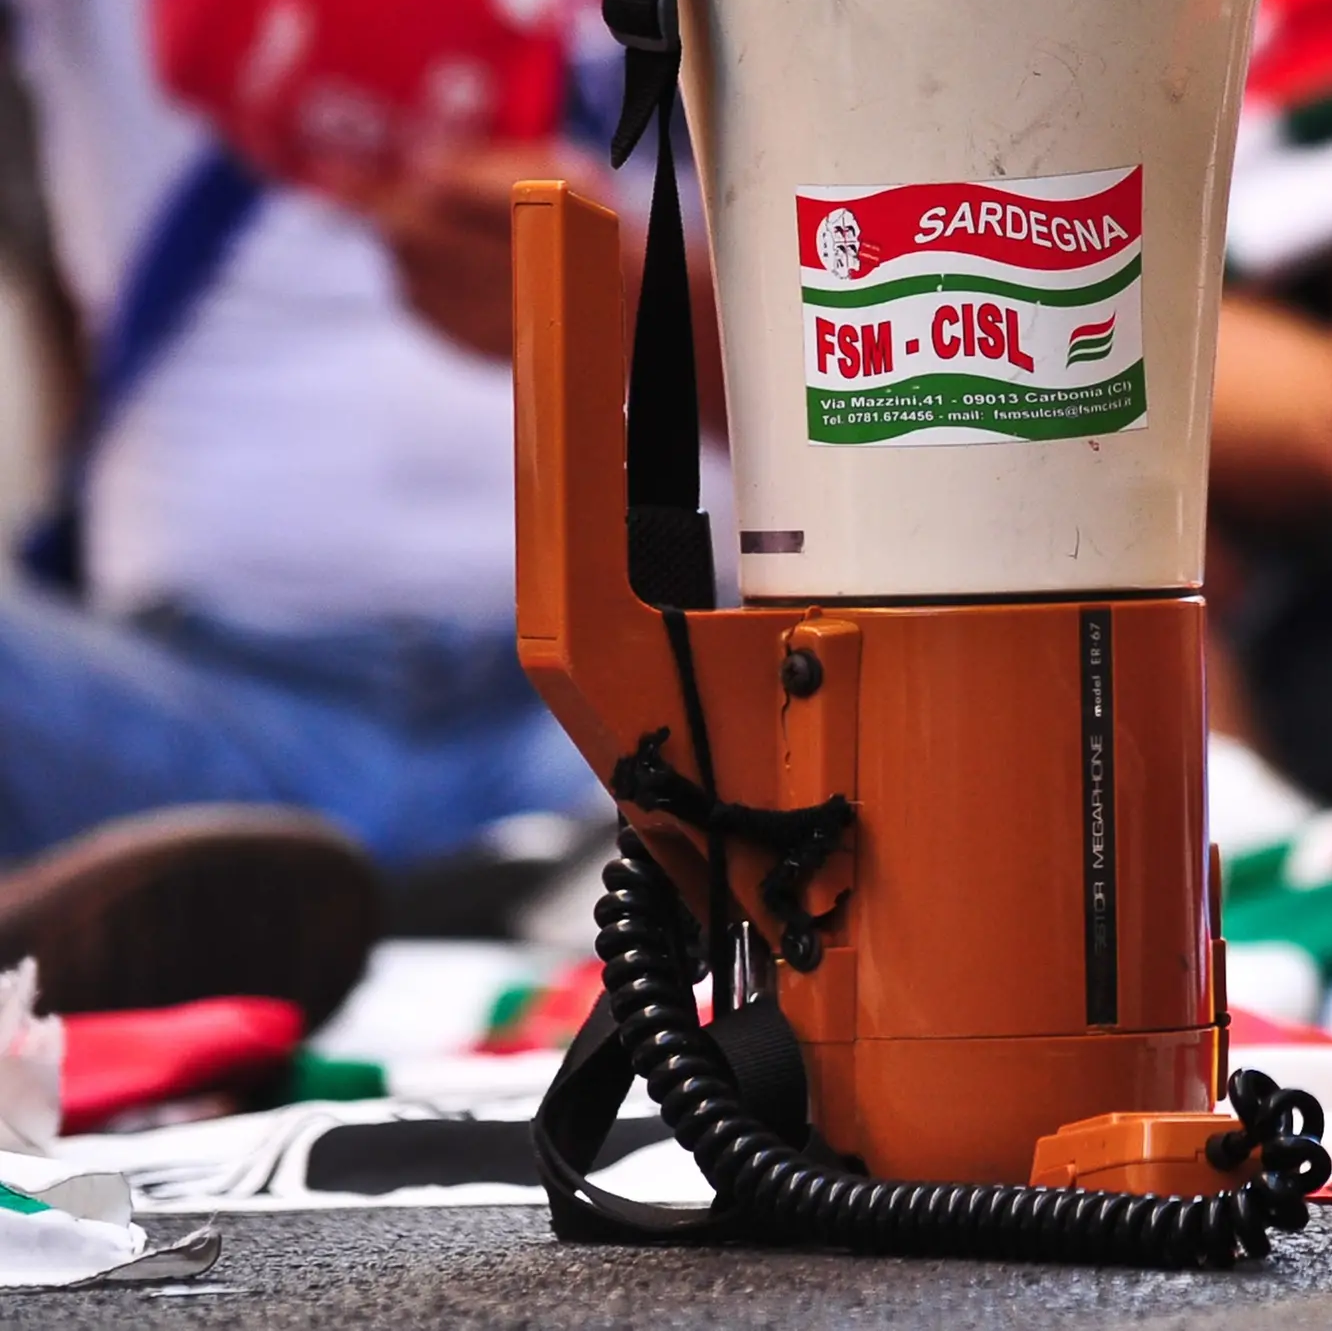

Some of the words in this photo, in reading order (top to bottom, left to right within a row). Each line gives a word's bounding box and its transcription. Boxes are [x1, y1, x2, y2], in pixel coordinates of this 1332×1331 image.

[914, 201, 1129, 252] SARDEGNA
[815, 316, 894, 379] FSM
[931, 303, 1035, 373] CISL
[820, 398, 846, 410] Via
[962, 393, 1019, 406] 09013
[1025, 387, 1103, 404] Carbonia
[1107, 381, 1133, 396] (CI)
[847, 410, 935, 424] 0781.674456
[947, 409, 985, 421] mail:
[1090, 675, 1103, 717] model
[1090, 734, 1104, 869] MEGAPHONE
